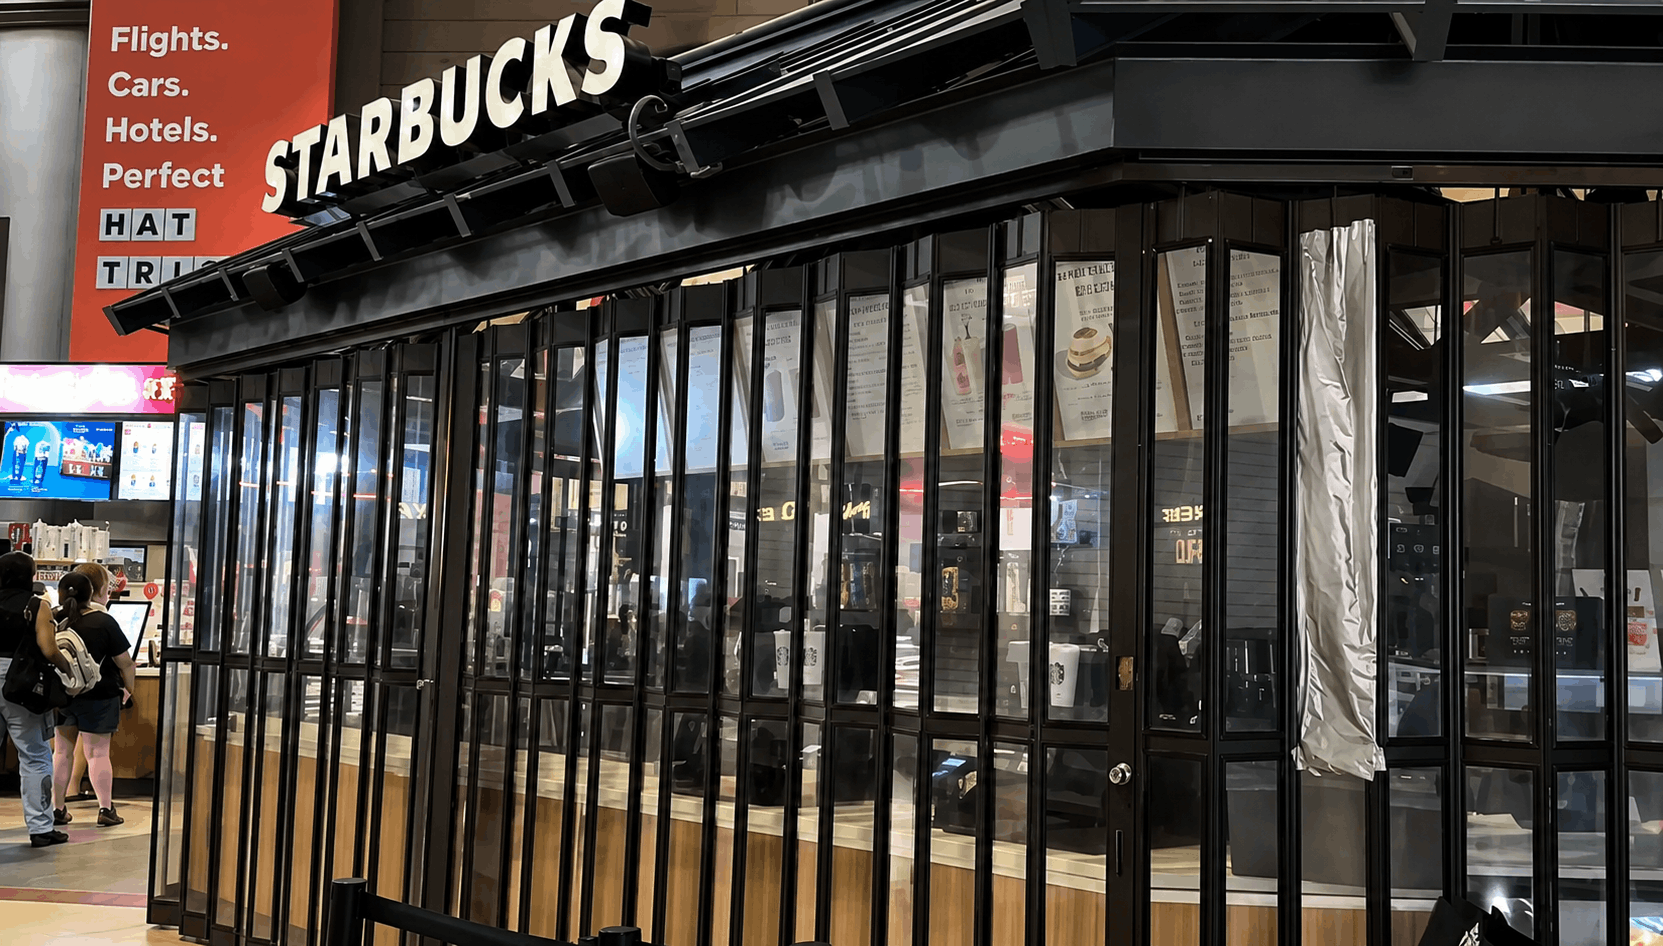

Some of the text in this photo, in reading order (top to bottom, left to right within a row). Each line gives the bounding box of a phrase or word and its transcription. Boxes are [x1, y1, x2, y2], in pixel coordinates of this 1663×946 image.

[111, 26, 229, 58] Flights.
[108, 71, 189, 97] Cars.
[261, 0, 626, 213] STARBUCKS
[105, 116, 217, 143] Hotels.
[103, 161, 225, 189] Perfect
[105, 213, 190, 235] HAT
[102, 260, 217, 284] TRI
